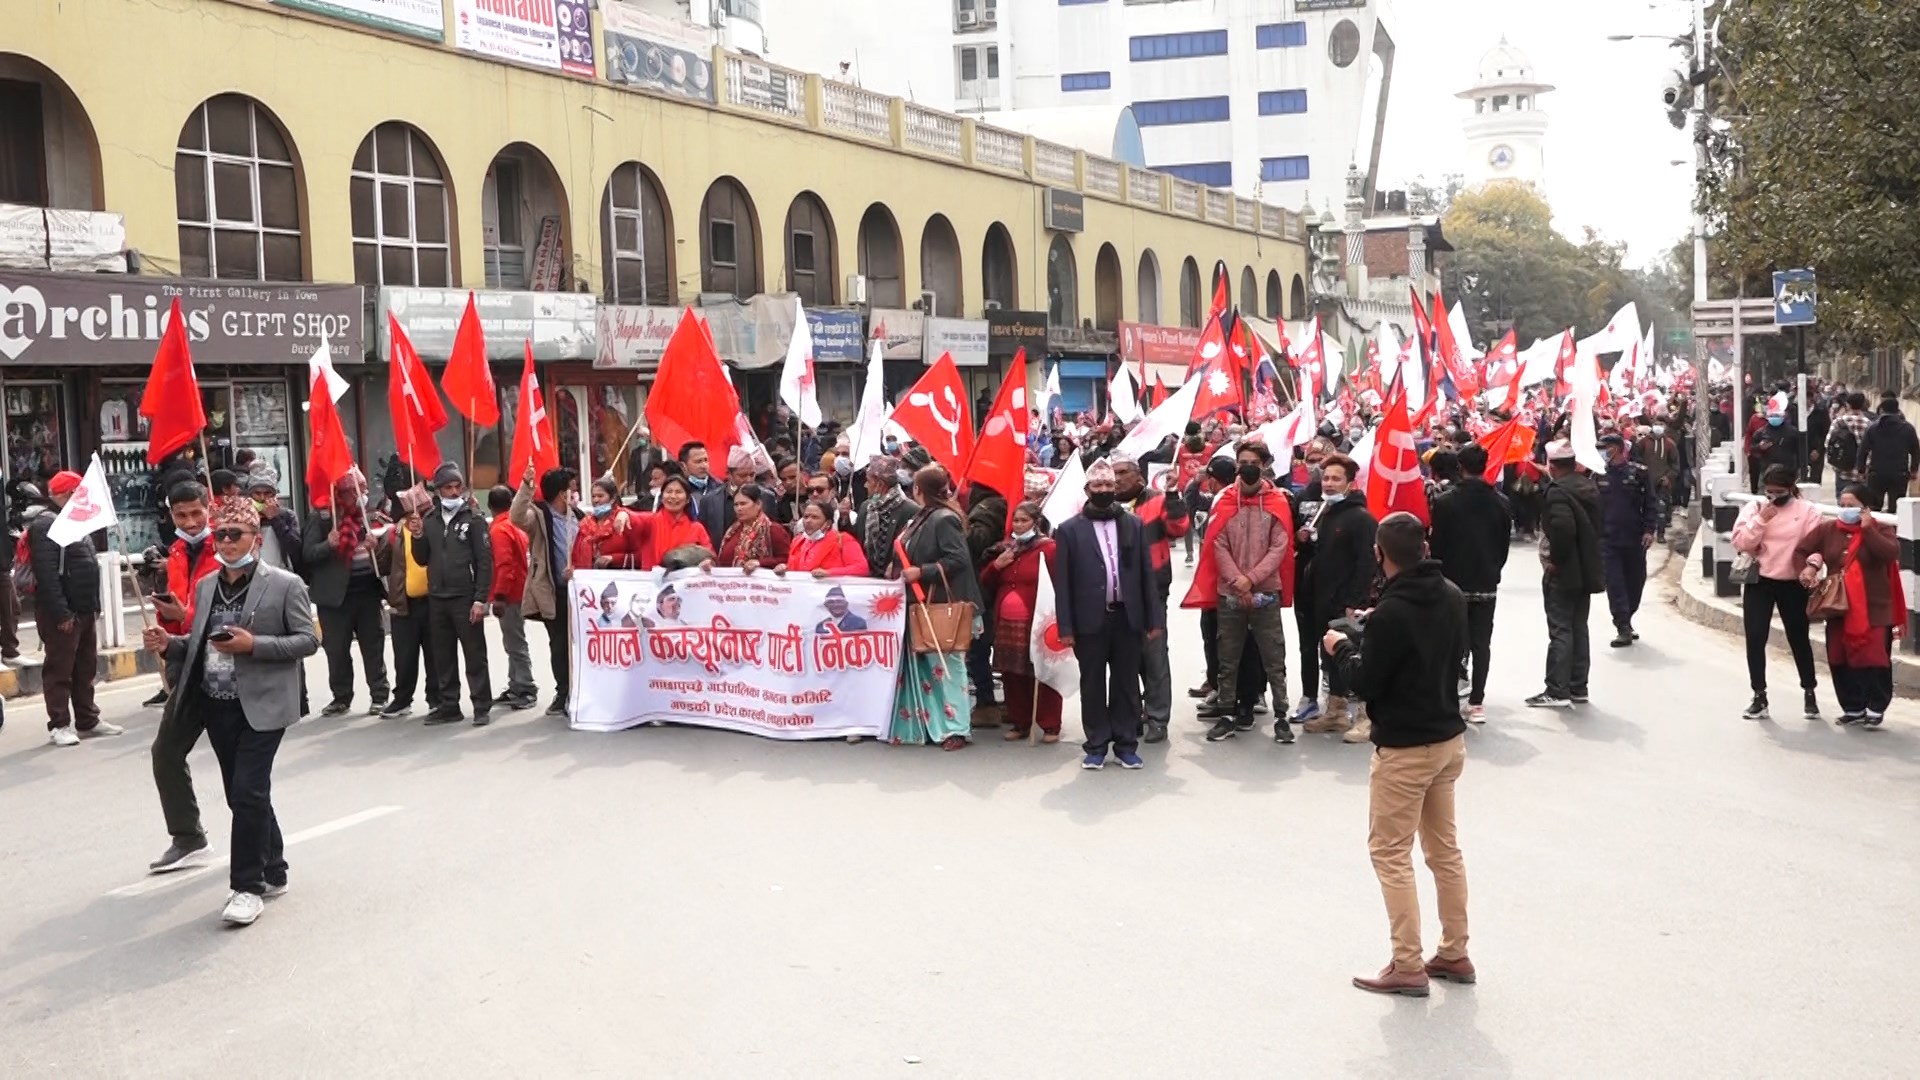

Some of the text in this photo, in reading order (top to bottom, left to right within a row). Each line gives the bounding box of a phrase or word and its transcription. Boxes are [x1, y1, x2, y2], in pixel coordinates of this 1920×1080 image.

[162, 285, 318, 302] The First Gallery in Town
[222, 310, 287, 337] GIFT
[293, 312, 351, 338] SHOP
[586, 617, 642, 667] नेपाल
[767, 623, 803, 672] पार्टी
